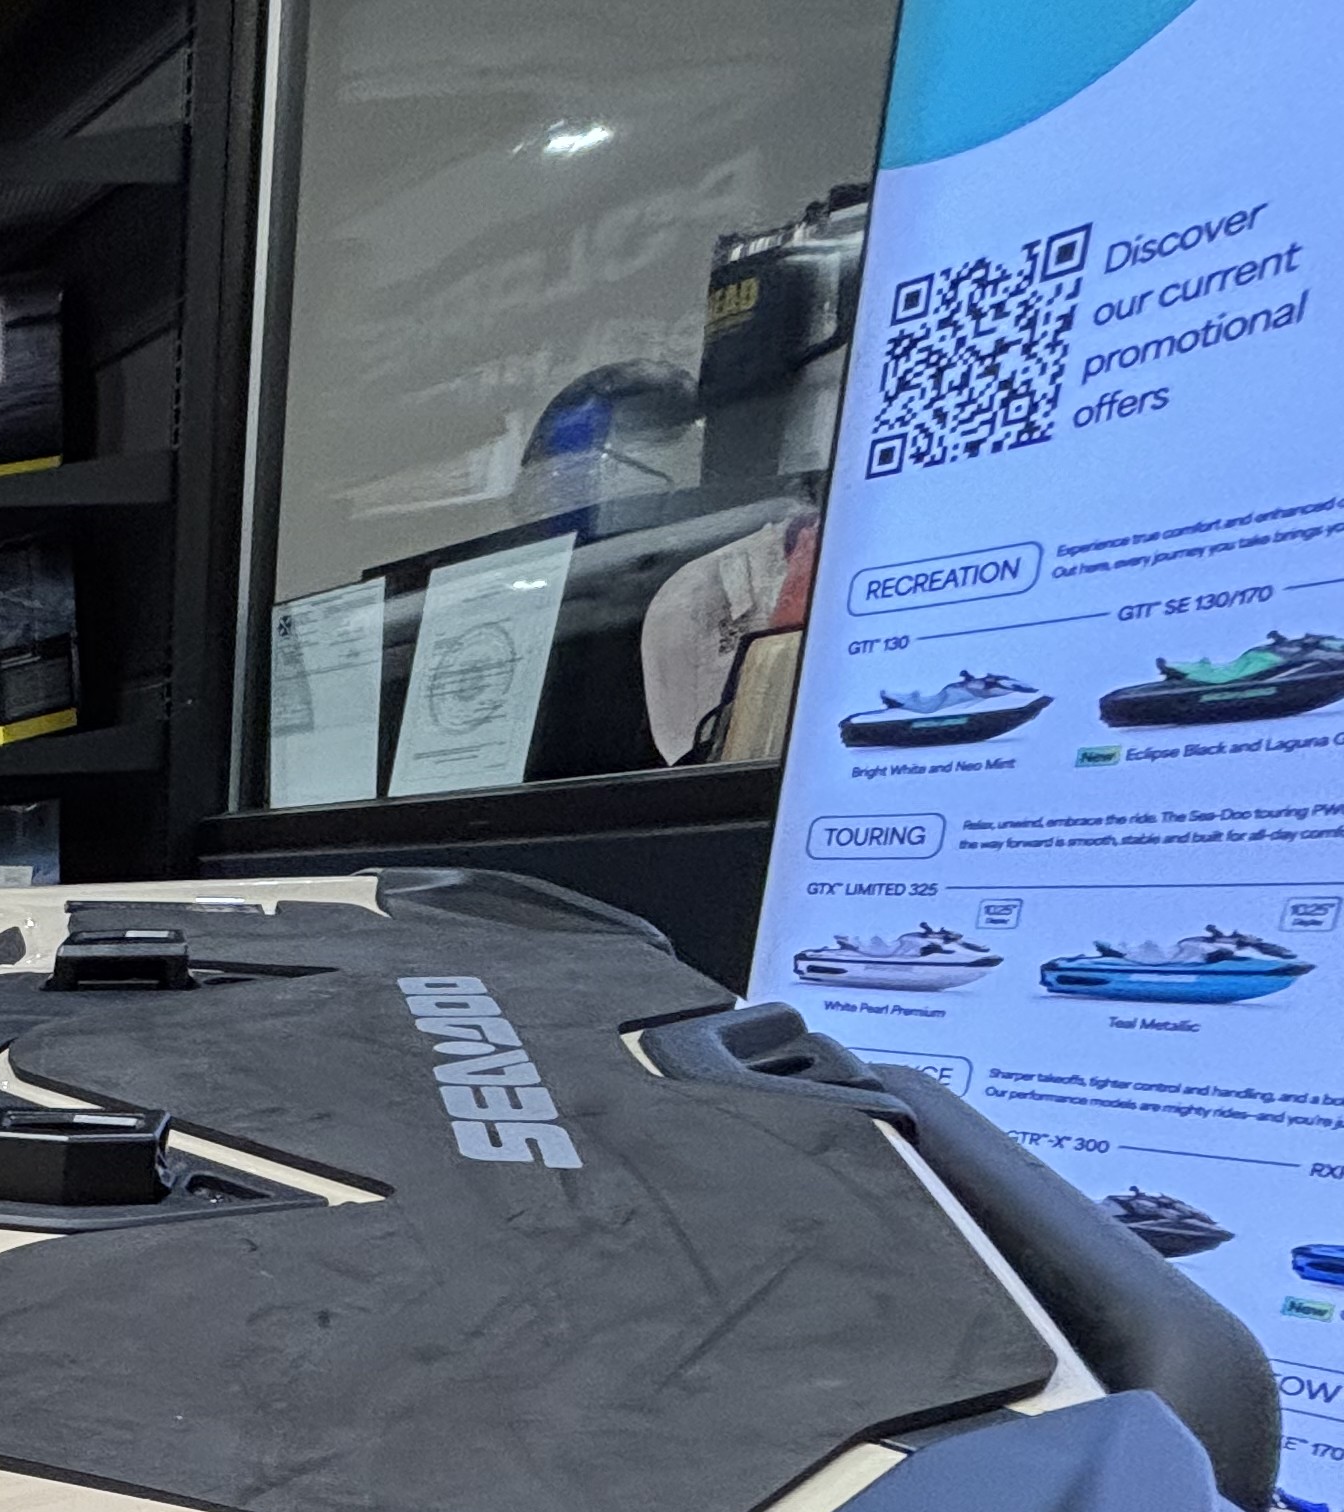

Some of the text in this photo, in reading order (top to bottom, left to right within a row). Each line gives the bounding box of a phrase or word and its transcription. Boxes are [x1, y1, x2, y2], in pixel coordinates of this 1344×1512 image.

[1104, 203, 1268, 275] Discover
[1093, 242, 1302, 325] our current
[1081, 289, 1309, 385] promotional
[1073, 387, 1169, 428] offers
[866, 557, 1021, 601] RECREATION
[1164, 596, 1193, 616] SE
[1195, 584, 1275, 611] 130/170
[883, 635, 910, 652] 130
[1125, 747, 1180, 763] Eclipse
[1182, 741, 1227, 758] Black
[1229, 738, 1263, 754] and
[1265, 735, 1330, 753] Laguna
[851, 757, 1017, 780] Bright White and Neo Mint
[1161, 809, 1186, 823] The
[1189, 806, 1252, 822] Sea-Doo
[1254, 804, 1310, 821] touring
[824, 826, 927, 847] TOURING
[1006, 837, 1054, 849] forward
[845, 882, 906, 897] LIMITED
[908, 883, 939, 897] 325
[824, 1000, 857, 1012] White
[1109, 1016, 1201, 1034] Teal Metallic
[989, 1067, 1036, 1083] Sharper
[1089, 1076, 1133, 1094] tighter
[1133, 1080, 1181, 1094] control
[1183, 1083, 1209, 1097] and
[1280, 1091, 1309, 1105] and
[984, 1085, 1007, 1098] Our
[1009, 1089, 1088, 1106] performance
[1089, 1095, 1137, 1110] models
[1139, 1101, 1160, 1113] are
[1162, 1102, 1212, 1118] mighty
[1074, 1138, 1110, 1154] 300
[1288, 1301, 1329, 1317] New
[1273, 1373, 1343, 1403] OW
